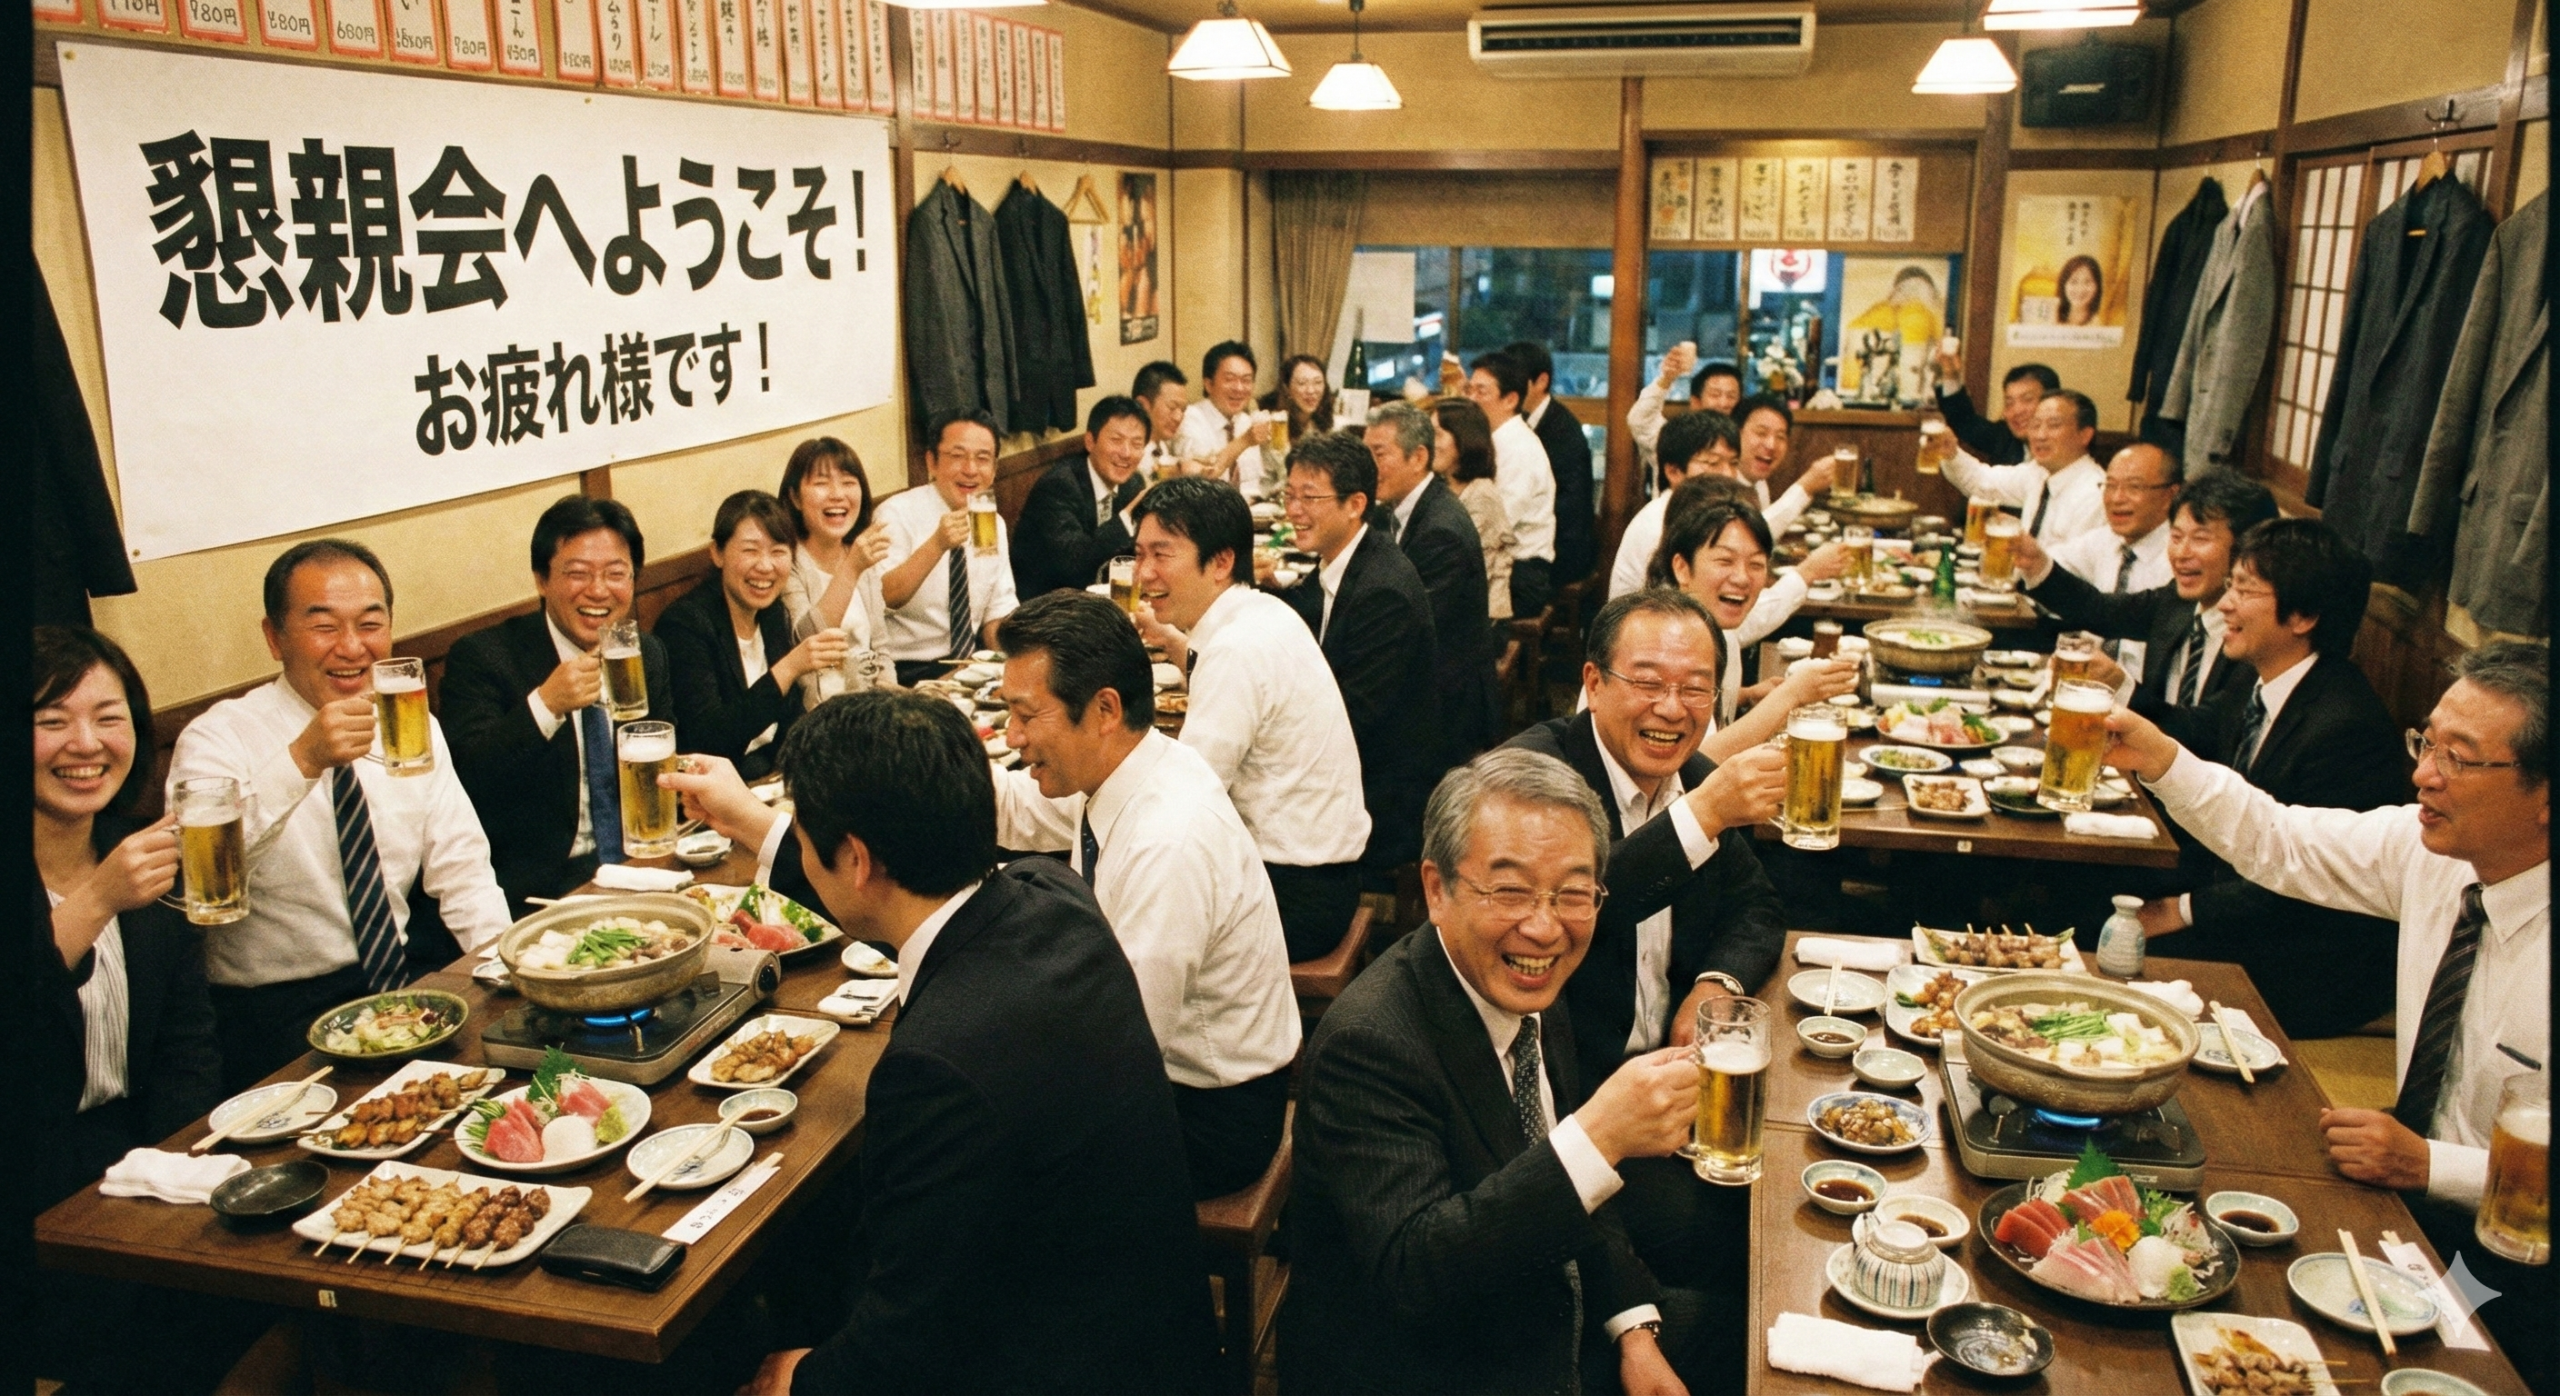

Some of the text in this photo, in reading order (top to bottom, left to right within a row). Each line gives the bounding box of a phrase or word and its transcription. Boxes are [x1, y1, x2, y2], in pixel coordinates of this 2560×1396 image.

[140, 129, 867, 330] 懇親会へようこそ！
[414, 321, 771, 456] お疲れ様です！
